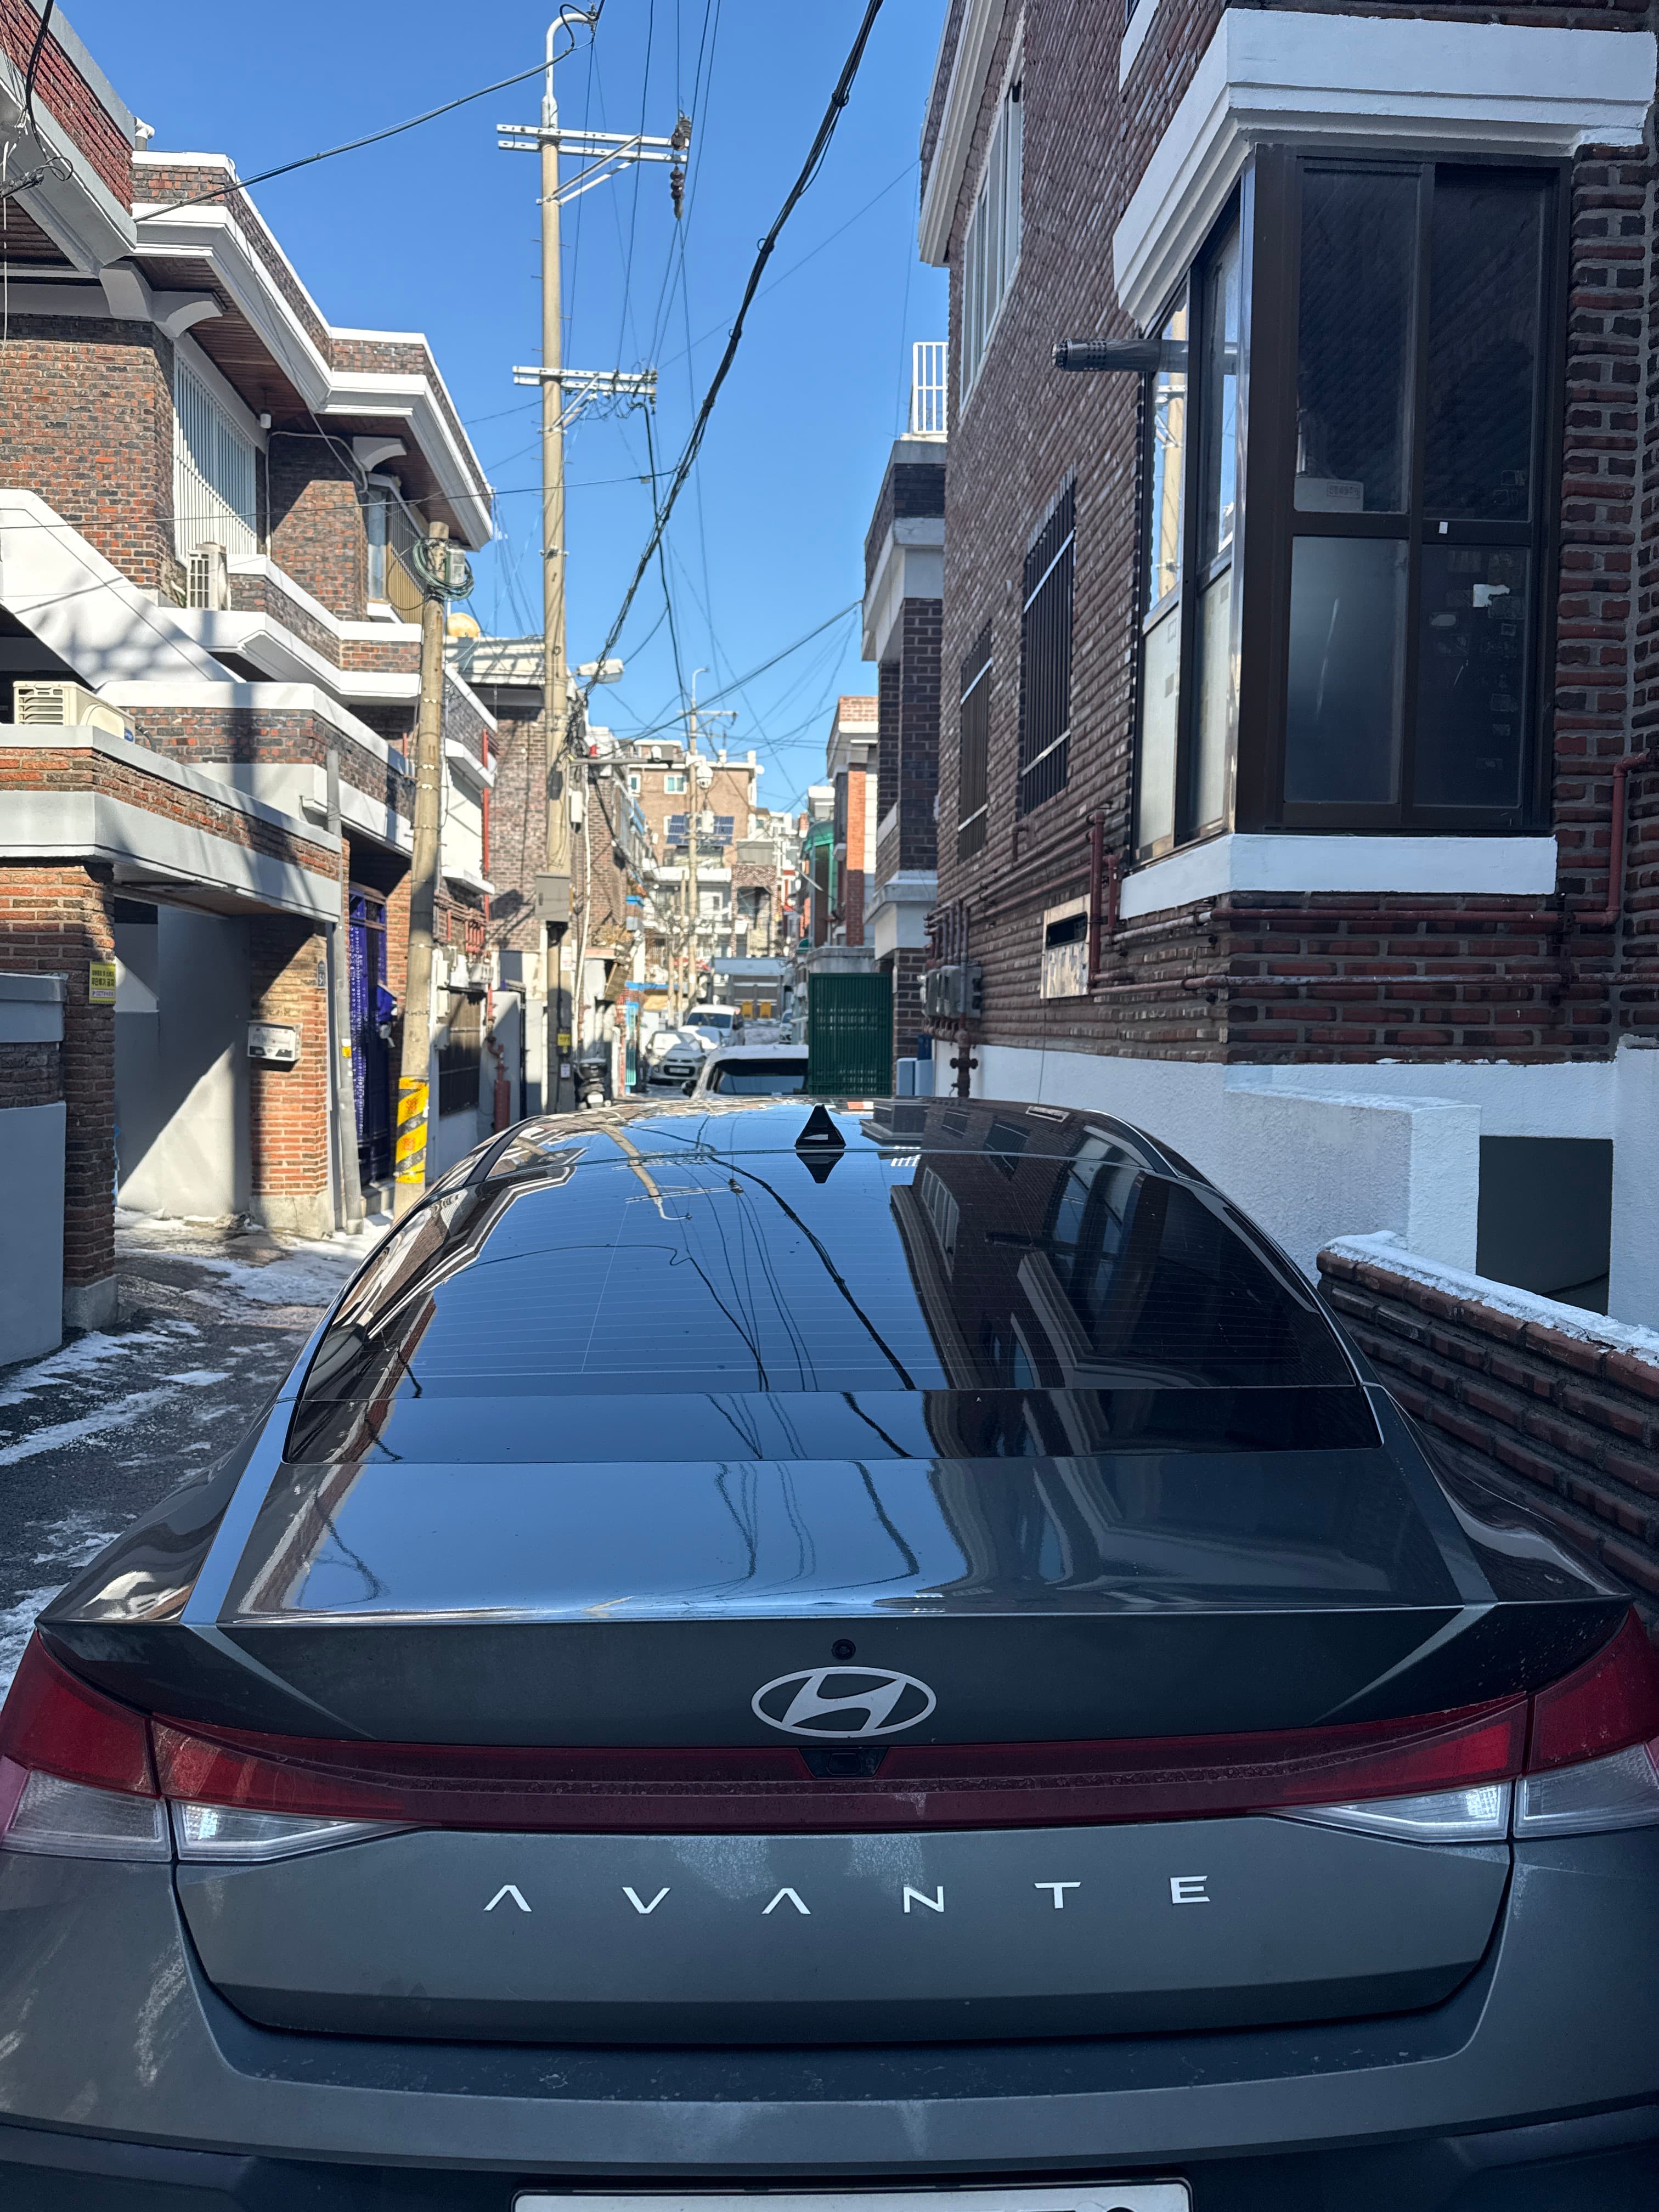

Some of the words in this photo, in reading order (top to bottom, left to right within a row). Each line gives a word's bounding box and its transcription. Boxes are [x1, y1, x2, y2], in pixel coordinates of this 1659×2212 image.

[92, 978, 106, 986] 무단투기
[107, 979, 115, 987] 금지
[483, 1875, 1210, 1915] AVANTE
